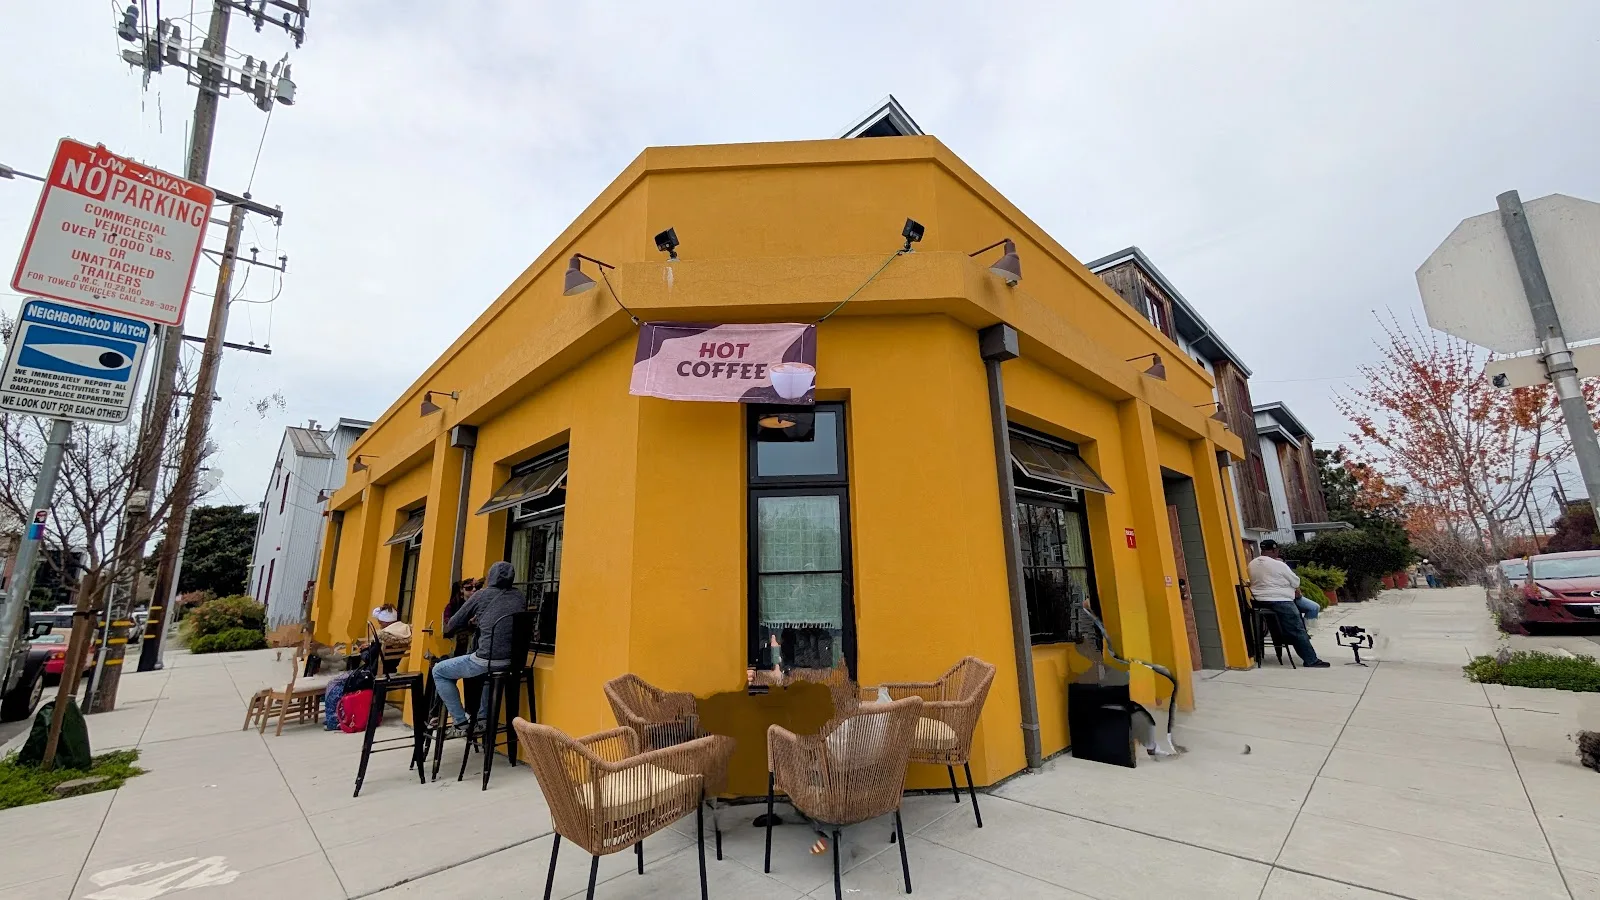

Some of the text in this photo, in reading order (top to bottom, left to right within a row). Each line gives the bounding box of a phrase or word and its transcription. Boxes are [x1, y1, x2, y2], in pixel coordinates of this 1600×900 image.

[61, 158, 205, 228] NO PARKING
[84, 203, 167, 236] COMMERCIAL
[94, 218, 154, 244] VEHICLES
[61, 221, 96, 239] OVER
[149, 249, 175, 262] LBS.
[71, 249, 155, 280] UNATTACHED
[109, 247, 126, 260] OR
[27, 271, 44, 281] FOR
[48, 275, 76, 289] TOWED
[79, 284, 116, 298] VEHICLES
[119, 293, 138, 304] CALL
[80, 264, 142, 288] TRAILERS
[103, 281, 142, 297] 10.28.160
[27, 304, 147, 339] NEIGHBORHOOD WATCH
[698, 342, 750, 359] HOT
[15, 368, 127, 391] WE IMMEDIATELY REPORT ALL
[676, 360, 768, 379] COFFEE
[10, 384, 123, 405] OAKLAND POLICE DEPARTMENT
[12, 376, 59, 389] SUSPICIOUS
[61, 383, 100, 395] ACTIVITIES
[2, 395, 15, 405] WE
[16, 397, 40, 409] LOOK
[40, 400, 58, 411] OUT
[58, 403, 74, 414] FOR
[74, 405, 96, 416] EACH
